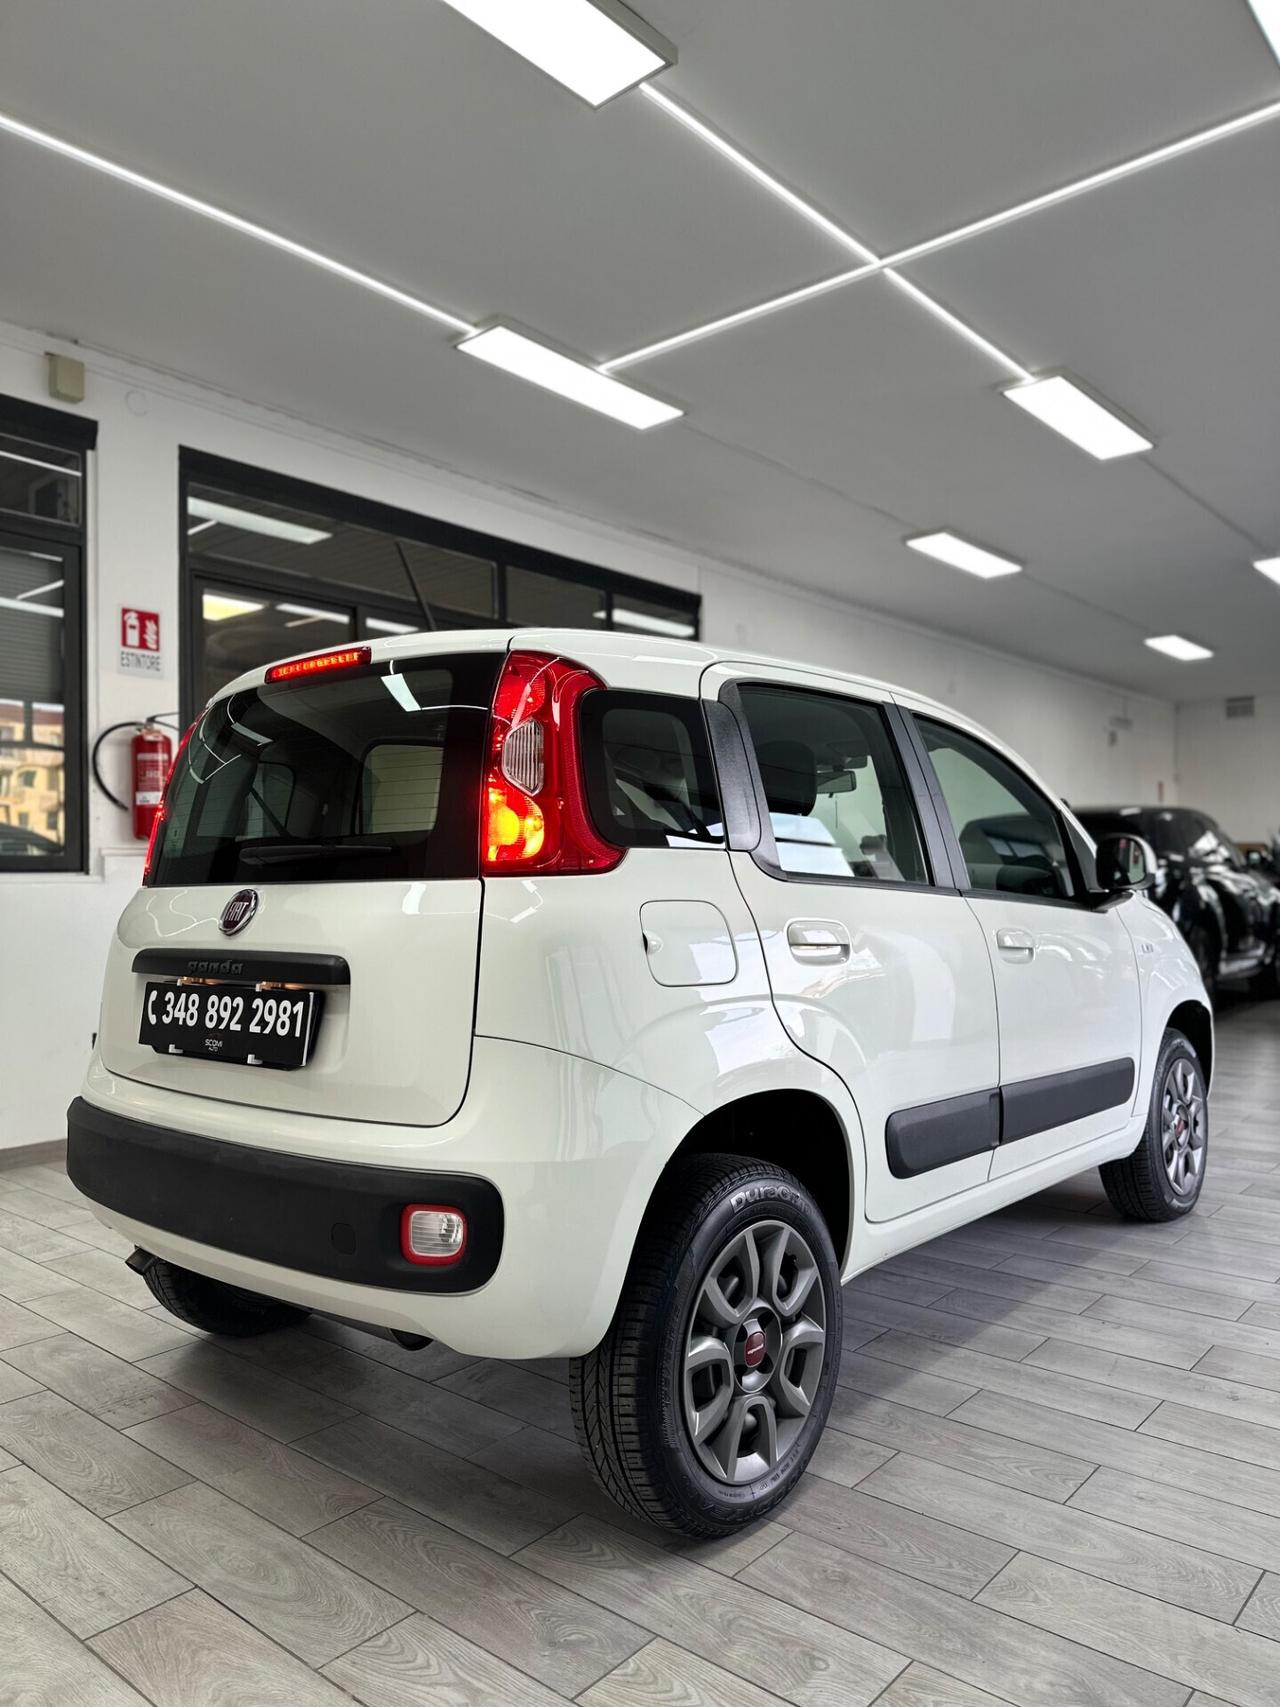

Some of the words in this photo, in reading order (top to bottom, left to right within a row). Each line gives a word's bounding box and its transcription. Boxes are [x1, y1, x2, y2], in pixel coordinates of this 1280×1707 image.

[120, 650, 161, 672] ESTINTORE
[225, 901, 250, 921] FIAT
[161, 991, 200, 1027] 348
[204, 994, 244, 1032] 892
[249, 997, 304, 1038] 2981
